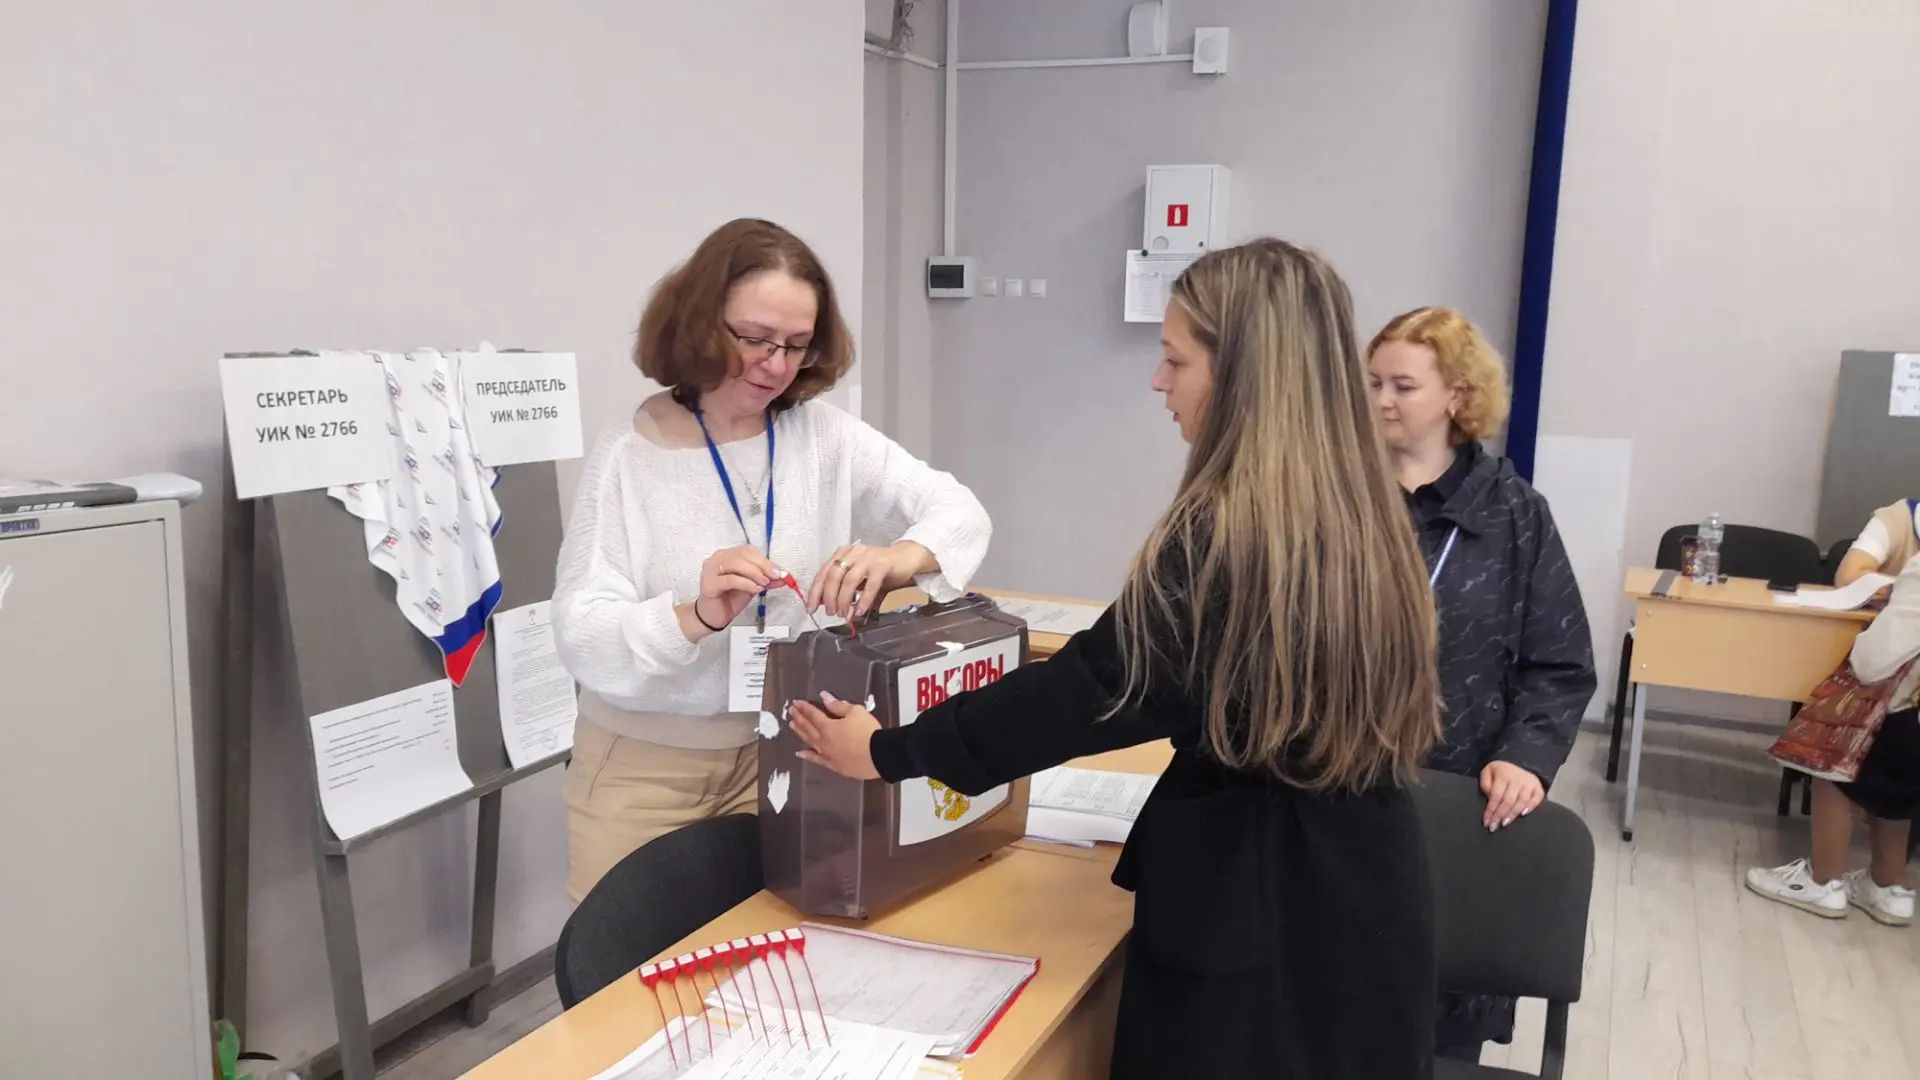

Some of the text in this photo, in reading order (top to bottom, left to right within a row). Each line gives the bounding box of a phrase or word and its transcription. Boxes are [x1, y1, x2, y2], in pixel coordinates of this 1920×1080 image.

[476, 378, 566, 397] ПРЕДСЕДАТЕЛЬ
[256, 388, 348, 408] СЕКРЕТАРЬ
[490, 405, 558, 424] УИК № 2766
[256, 420, 358, 443] УИК № 2766
